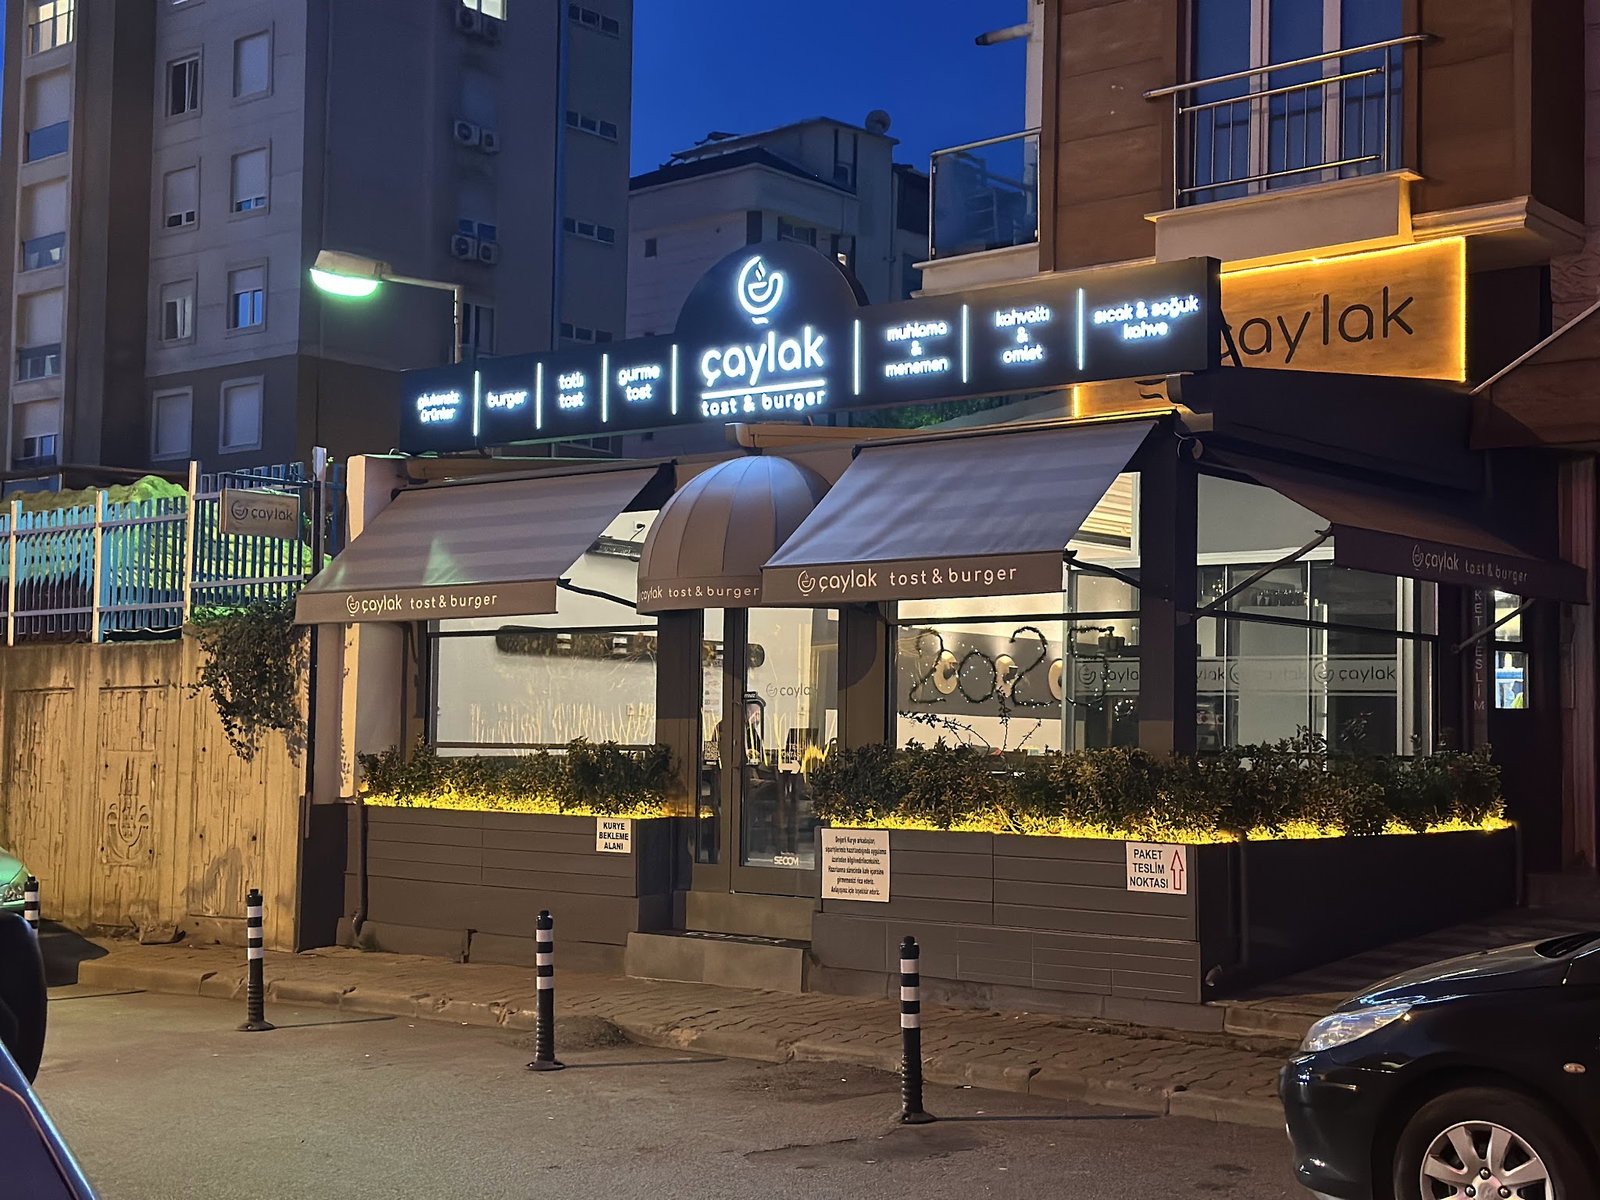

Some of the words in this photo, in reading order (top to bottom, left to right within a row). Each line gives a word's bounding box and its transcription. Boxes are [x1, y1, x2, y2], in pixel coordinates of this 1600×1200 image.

[995, 306, 1050, 327] kahvaltı
[1094, 303, 1133, 324] sıcak
[1136, 301, 1148, 319] &
[1151, 295, 1199, 318] soğuk
[887, 322, 948, 342] muhlama
[1123, 320, 1168, 339] kahve
[1221, 286, 1414, 363] aylak
[1017, 327, 1029, 343] &
[701, 326, 824, 387] çaylak
[911, 341, 922, 356] &
[1003, 344, 1043, 363] omlet
[618, 365, 660, 386] gurme
[886, 358, 948, 377] menemen
[487, 391, 527, 409] burger
[559, 391, 585, 408] tost
[625, 384, 652, 401] tost
[702, 398, 737, 417] tost
[743, 394, 756, 412] &
[761, 390, 826, 411] burger
[420, 407, 456, 422] ürünler
[1424, 551, 1459, 573] çaylak
[818, 568, 878, 593] çaylak
[948, 567, 1017, 586] burger
[706, 586, 760, 599] burger
[361, 594, 403, 615] çaylak
[450, 594, 498, 609] burger
[1474, 590, 1483, 627] KET
[1338, 666, 1396, 684] çaylak
[603, 822, 625, 830] KURYE
[599, 831, 629, 841] BEKLEME
[604, 841, 624, 850] ALANI
[1133, 848, 1163, 860] PAKET
[774, 855, 799, 866] SECOM
[1132, 862, 1165, 874] TESLİM
[1129, 876, 1169, 889] NOKTASI
